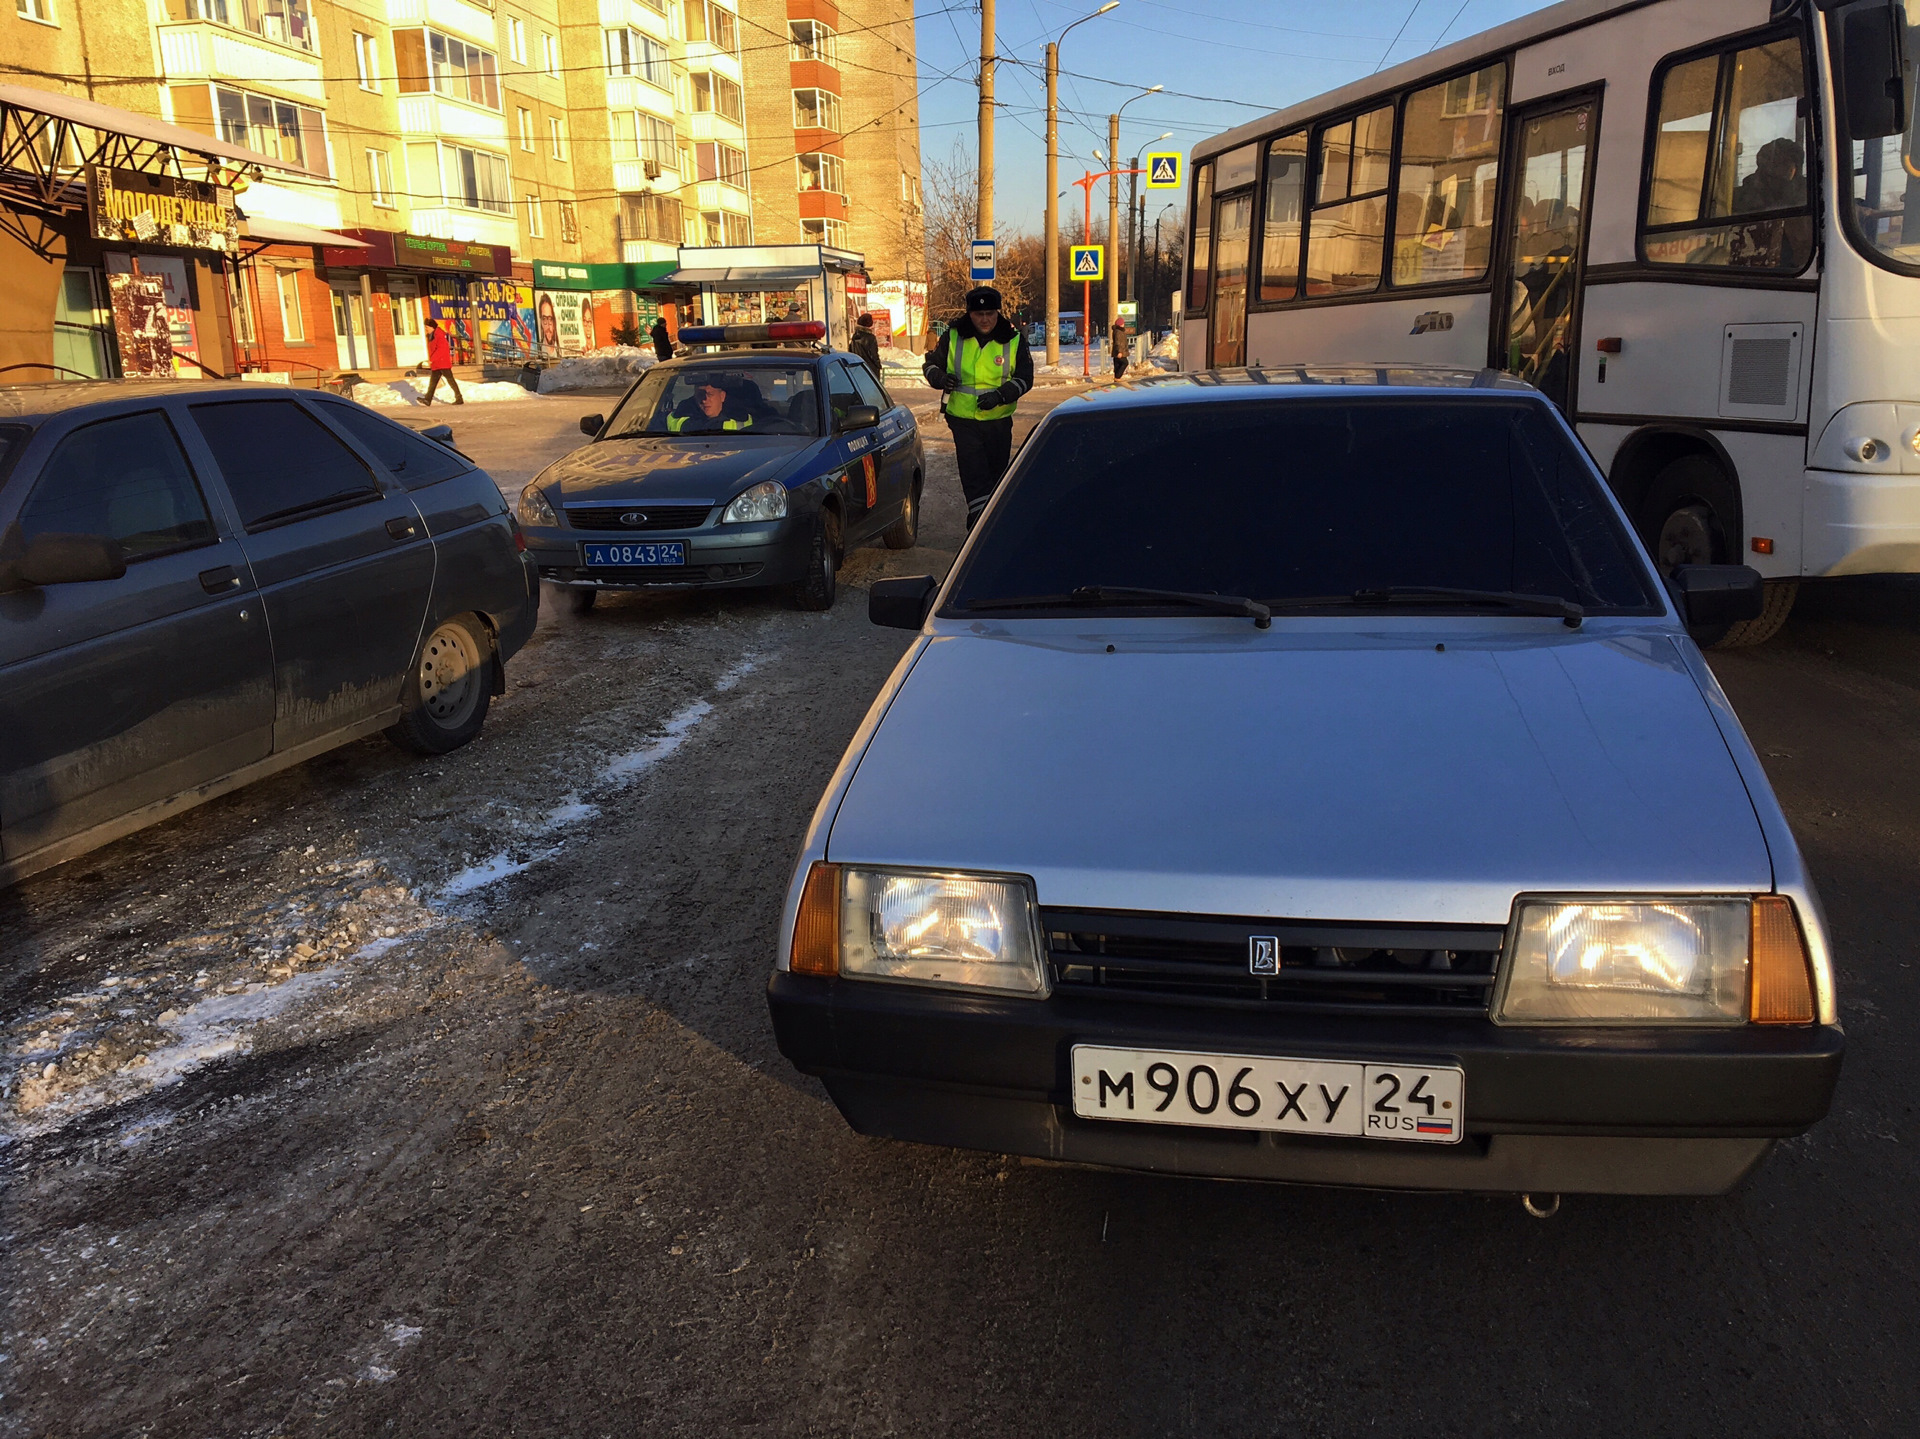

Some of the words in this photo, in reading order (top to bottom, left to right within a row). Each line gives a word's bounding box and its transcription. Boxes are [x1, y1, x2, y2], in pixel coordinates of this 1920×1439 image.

[1548, 63, 1565, 76] ВХОД
[104, 188, 227, 232] МОЛОДЕЖНАЯ
[556, 294, 579, 307] ОПРАВЫ
[561, 309, 576, 322] ОЧКИ
[661, 545, 678, 558] 24
[1373, 1072, 1436, 1116] 24
[1367, 1114, 1414, 1130] RUS
